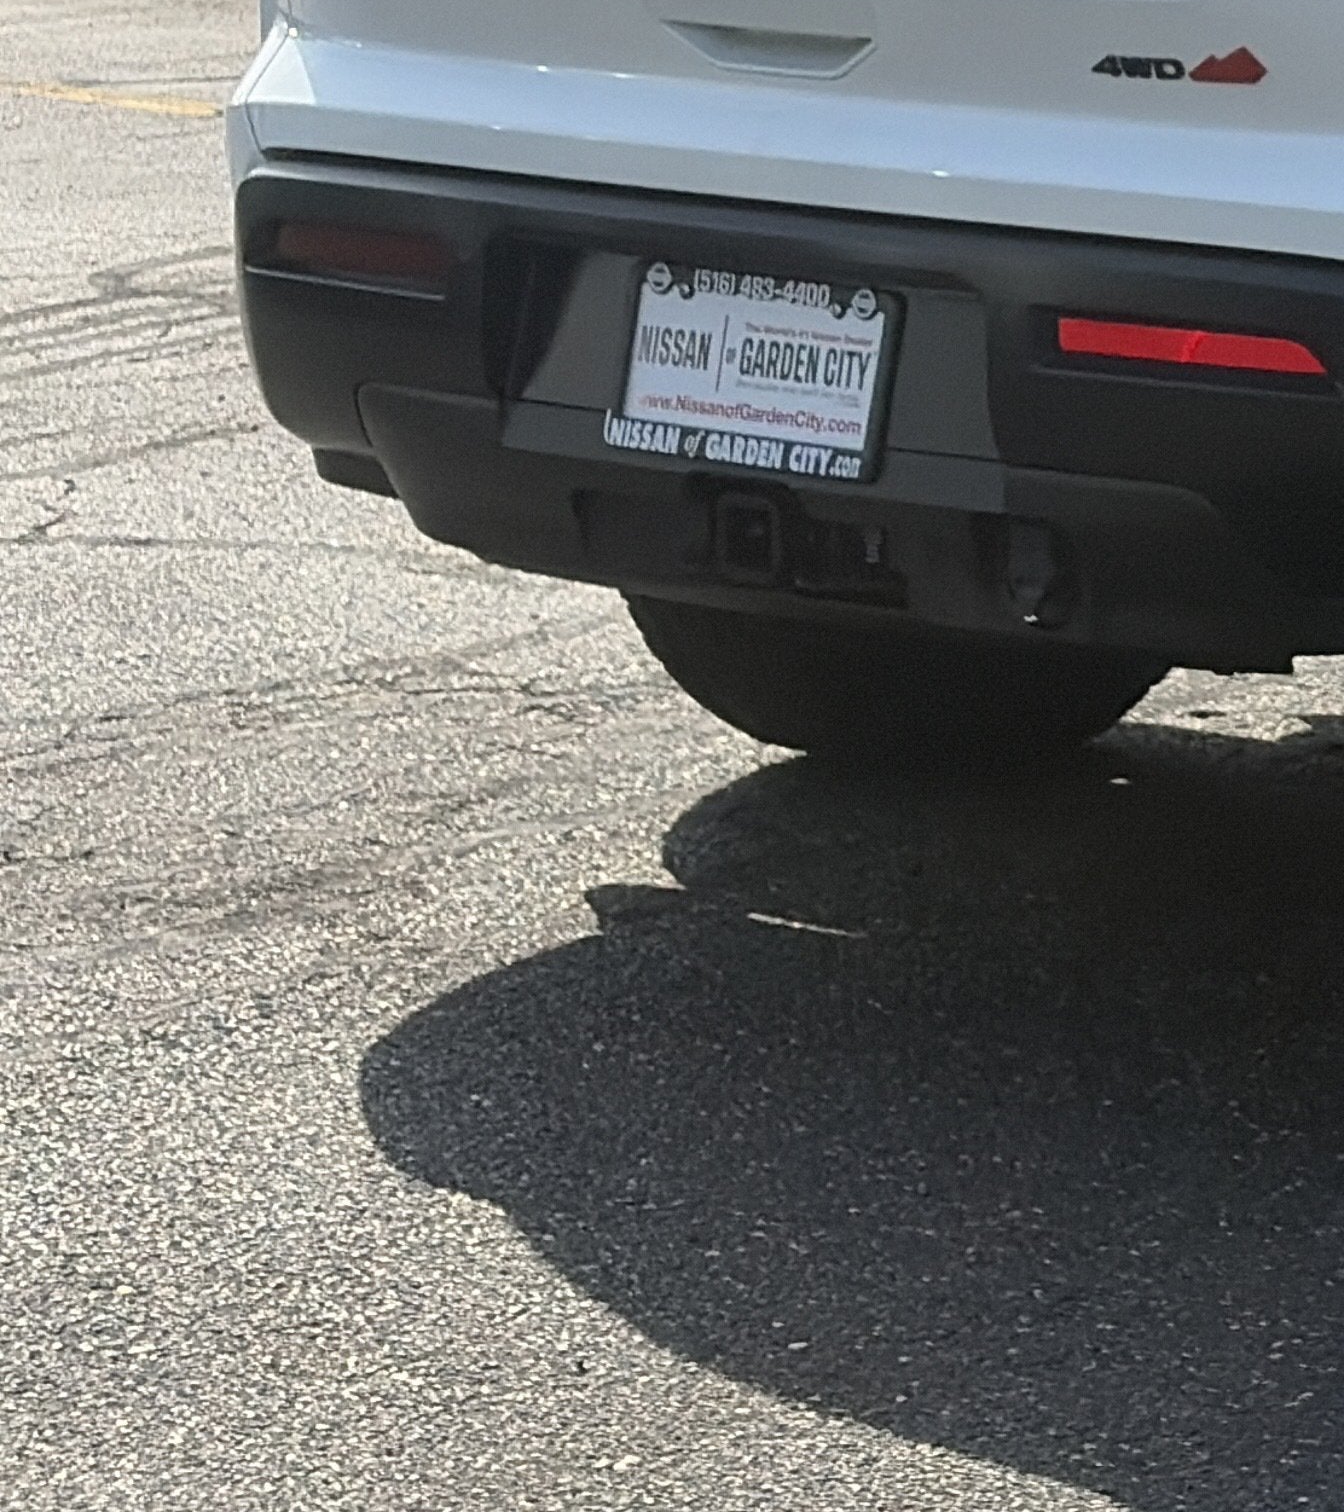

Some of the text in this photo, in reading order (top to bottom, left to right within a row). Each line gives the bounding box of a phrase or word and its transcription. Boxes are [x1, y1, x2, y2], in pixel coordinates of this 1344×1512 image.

[1091, 53, 1186, 80] 4WD
[693, 267, 736, 296] (516)
[637, 325, 712, 371] NISSAN
[739, 337, 820, 385] GARDEN
[823, 348, 872, 391] CITY
[608, 417, 682, 455] NISSAN
[705, 432, 785, 470] GARDEN
